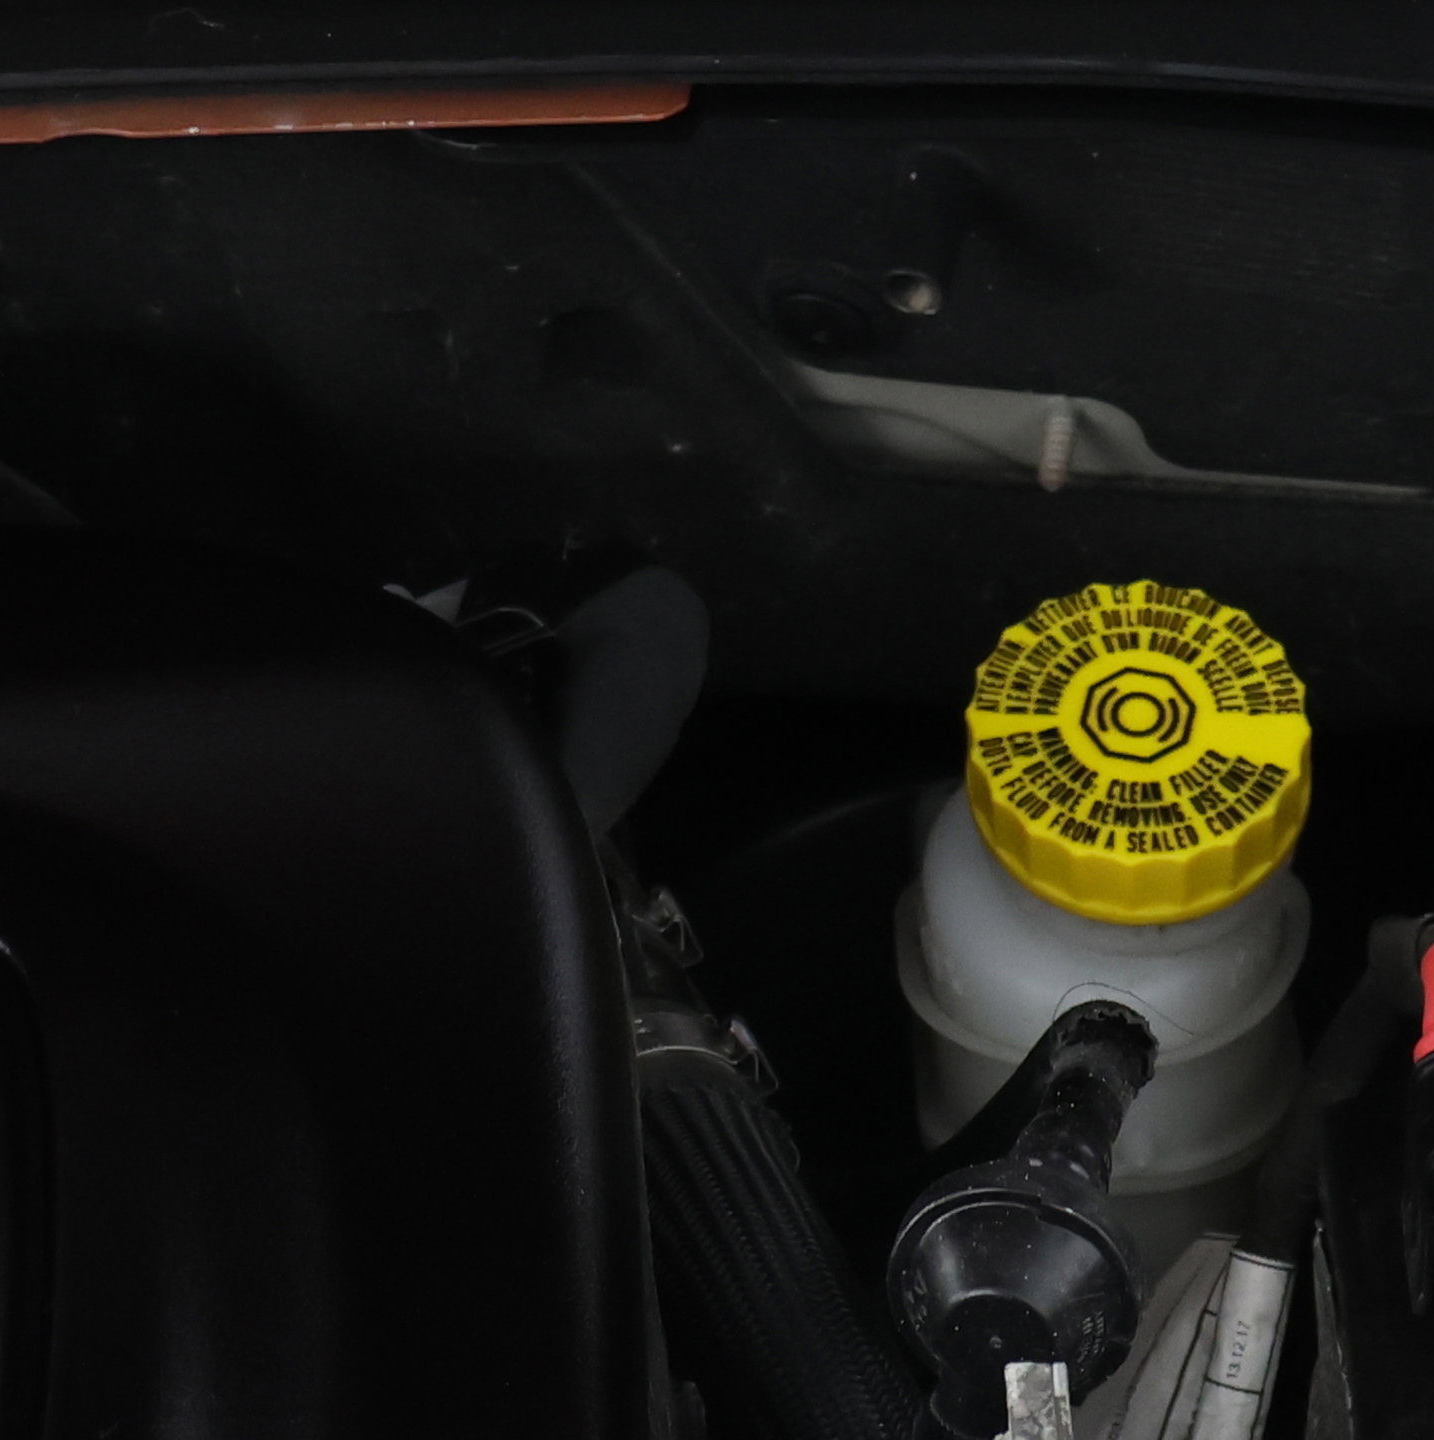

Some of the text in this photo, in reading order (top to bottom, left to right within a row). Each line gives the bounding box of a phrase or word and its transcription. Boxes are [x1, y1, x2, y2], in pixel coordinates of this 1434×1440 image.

[976, 639, 1023, 712] ATTENTION
[1007, 731, 1038, 757] CAP
[979, 737, 1289, 854] DOT4 FLUID FROM A SEALED CONTAINER
[1021, 761, 1086, 814] BEFORE
[1106, 779, 1162, 804] CLEAN
[1169, 749, 1230, 797] FILLER
[1218, 755, 1259, 793] ONLY
[1188, 788, 1223, 816] USE
